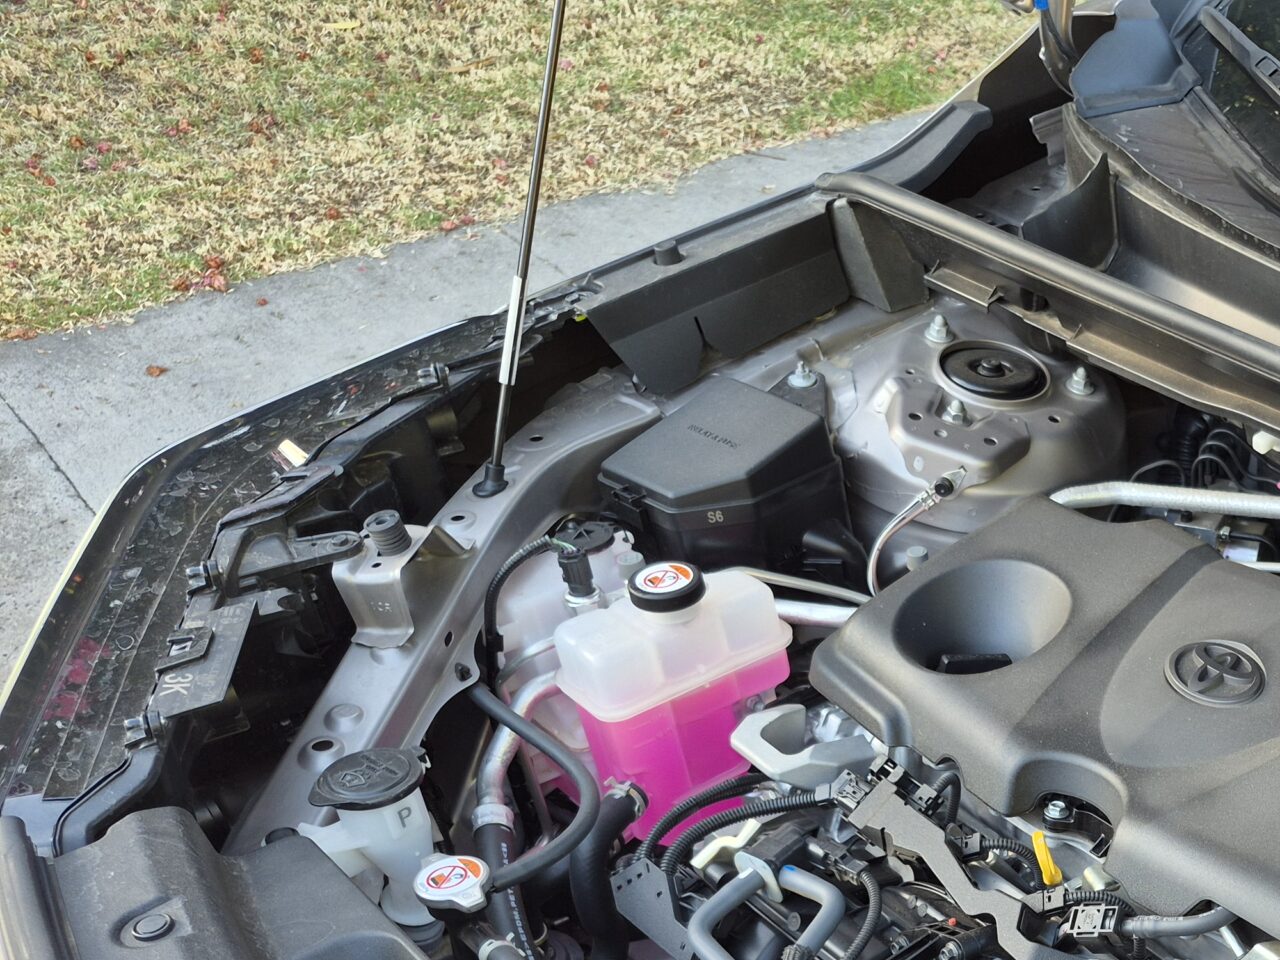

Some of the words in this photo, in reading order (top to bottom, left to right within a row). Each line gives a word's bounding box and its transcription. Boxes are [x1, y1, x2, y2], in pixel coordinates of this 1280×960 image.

[707, 510, 724, 524] S6
[159, 672, 194, 696] 3K
[397, 806, 412, 828] P
